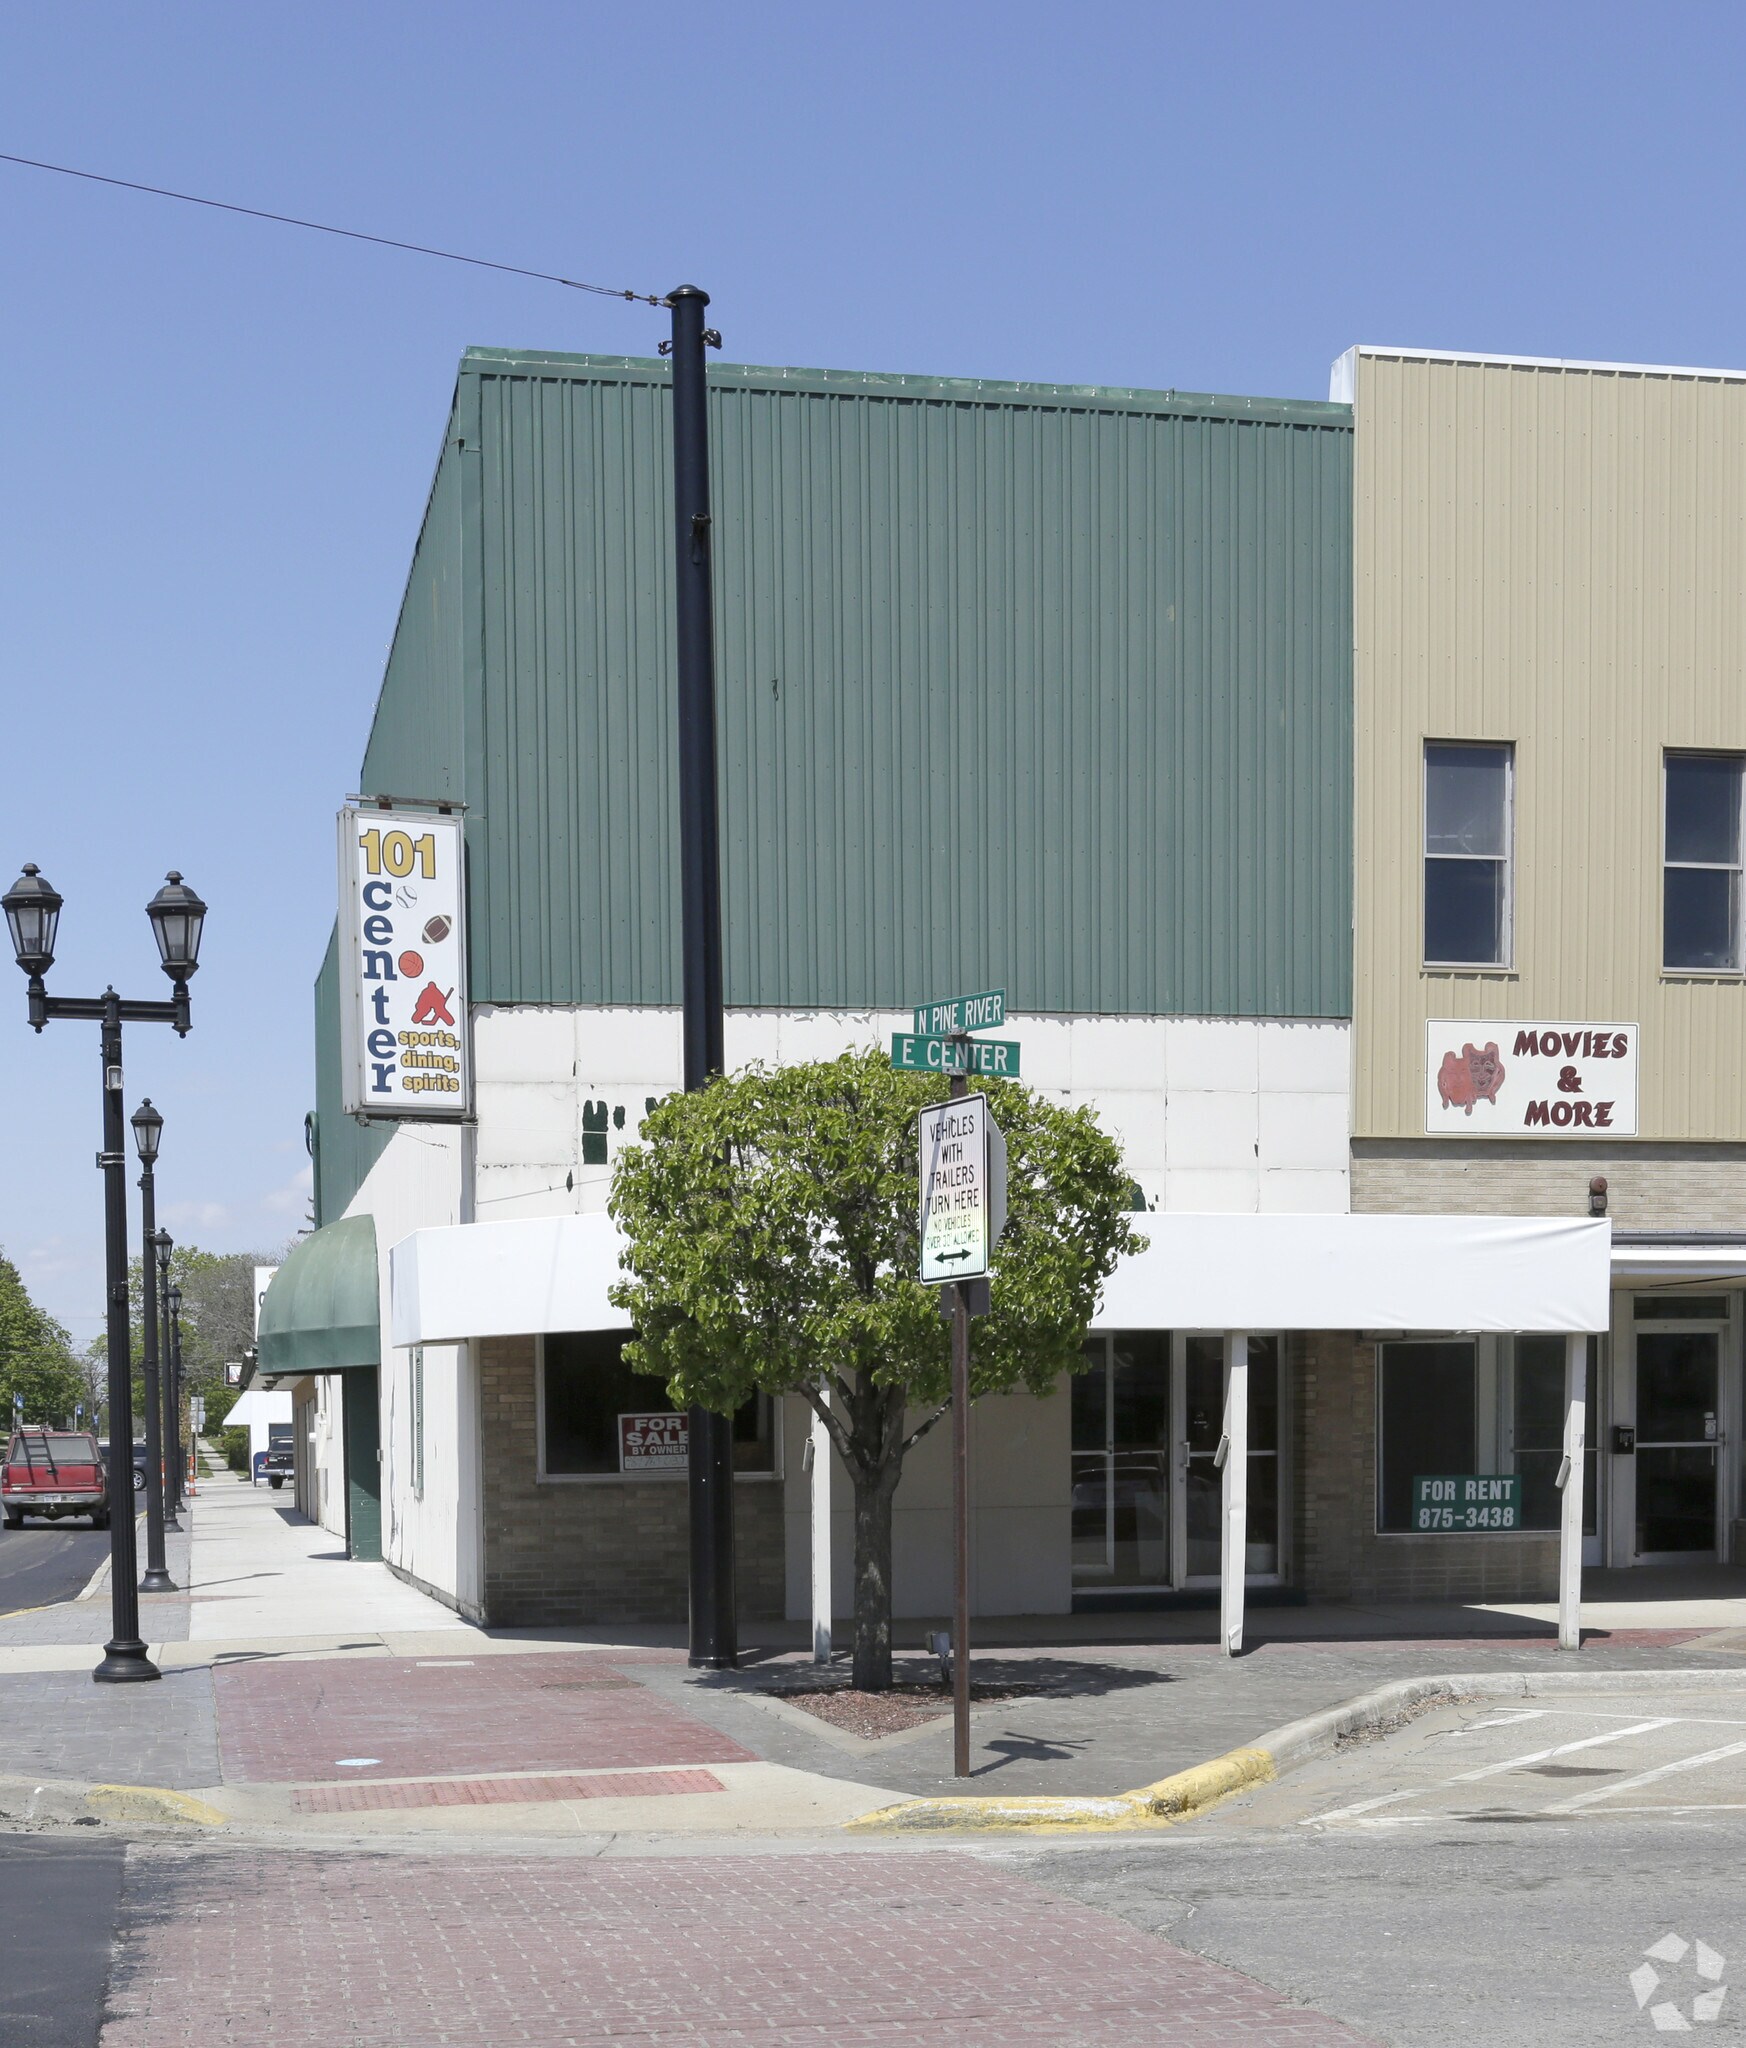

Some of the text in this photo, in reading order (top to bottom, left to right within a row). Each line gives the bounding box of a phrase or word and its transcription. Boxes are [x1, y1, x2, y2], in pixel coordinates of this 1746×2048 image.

[359, 828, 436, 880] 101
[362, 880, 397, 1093] center
[918, 995, 1001, 1034] N PINE RIVER
[398, 1030, 460, 1051] sports,
[1512, 1029, 1628, 1059] MOVIES
[401, 1050, 459, 1073] dining,
[902, 1038, 1008, 1071] E CENTER
[402, 1073, 460, 1093] spirits
[1557, 1065, 1584, 1093] &
[1524, 1100, 1615, 1127] MORE
[930, 1114, 975, 1143] VEHICLES
[941, 1142, 963, 1164] WITH
[931, 1164, 975, 1192] TRAILERS
[926, 1188, 979, 1216] TURN HERE
[944, 1214, 971, 1231] VEHICLES
[634, 1418, 682, 1432] FOR
[626, 1431, 688, 1446] SALE
[632, 1445, 687, 1455] BY OWNER
[1421, 1480, 1514, 1501] FOR RENT
[1418, 1507, 1514, 1528] 875-3438
